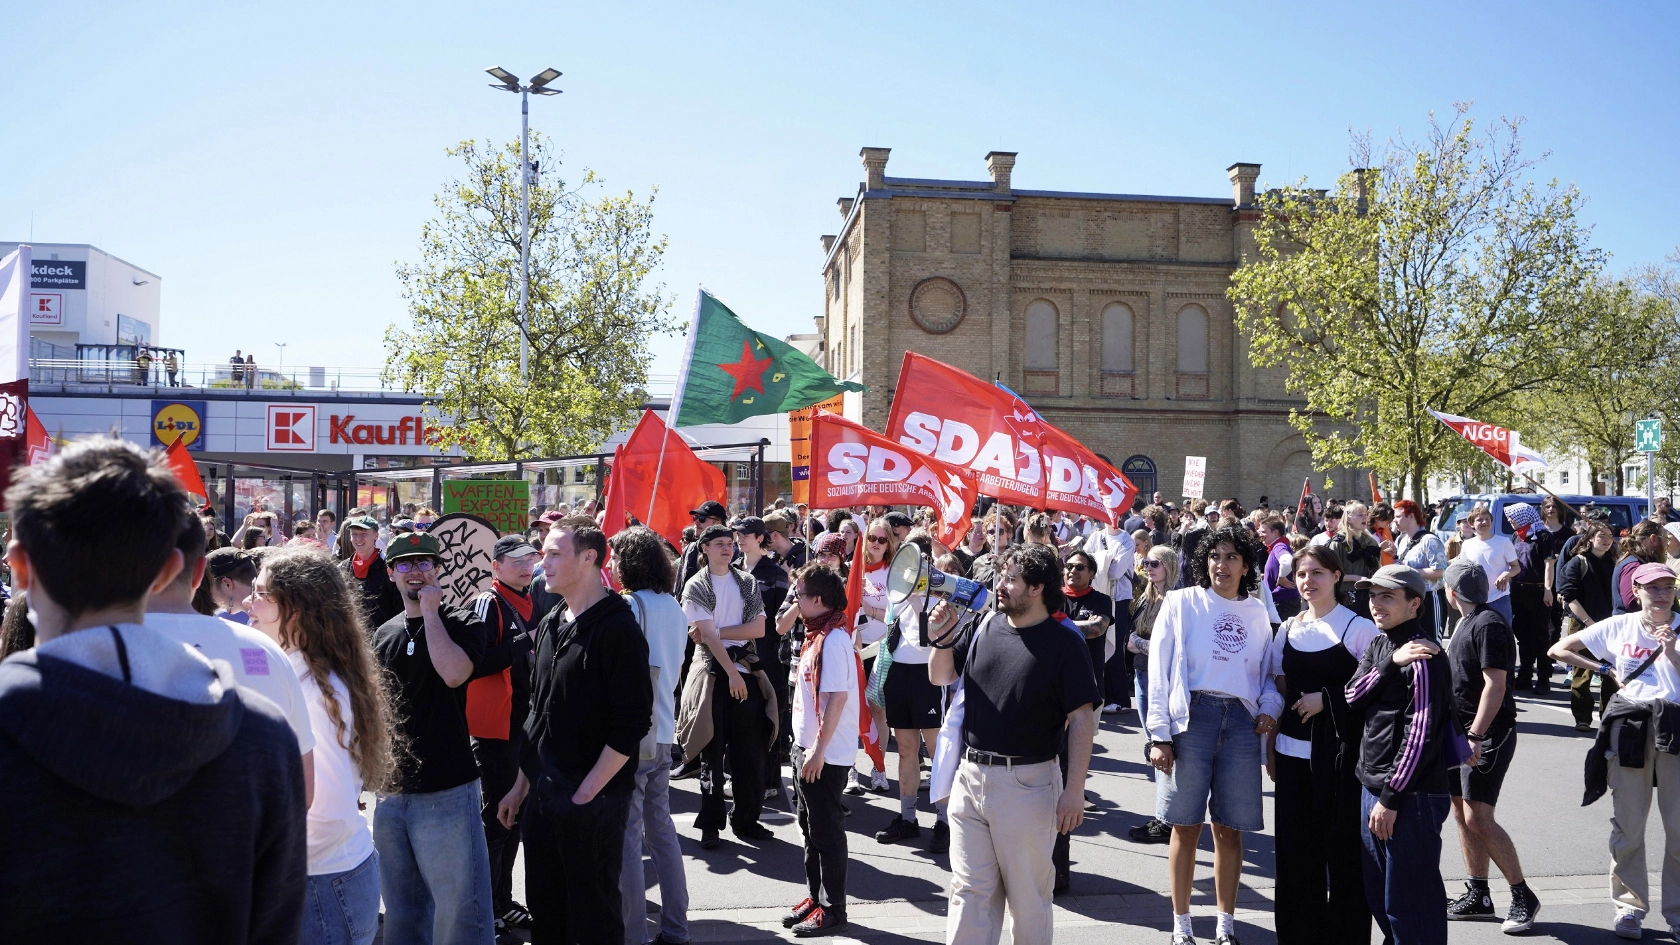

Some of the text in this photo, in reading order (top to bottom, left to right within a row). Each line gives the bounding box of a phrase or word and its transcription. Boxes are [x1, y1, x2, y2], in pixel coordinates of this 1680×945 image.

[1461, 424, 1507, 441] NGG
[900, 411, 1041, 485] SDAJ
[1189, 459, 1200, 467] NIE
[1185, 471, 1205, 479] WIEDER
[827, 483, 878, 497] SOZIALISTISCHE
[879, 484, 917, 494] DEUTSCHE
[979, 472, 1039, 497] ARBEITERJUGEND
[460, 498, 528, 513] EXPORTE
[1060, 493, 1088, 506] DEUTSCHE
